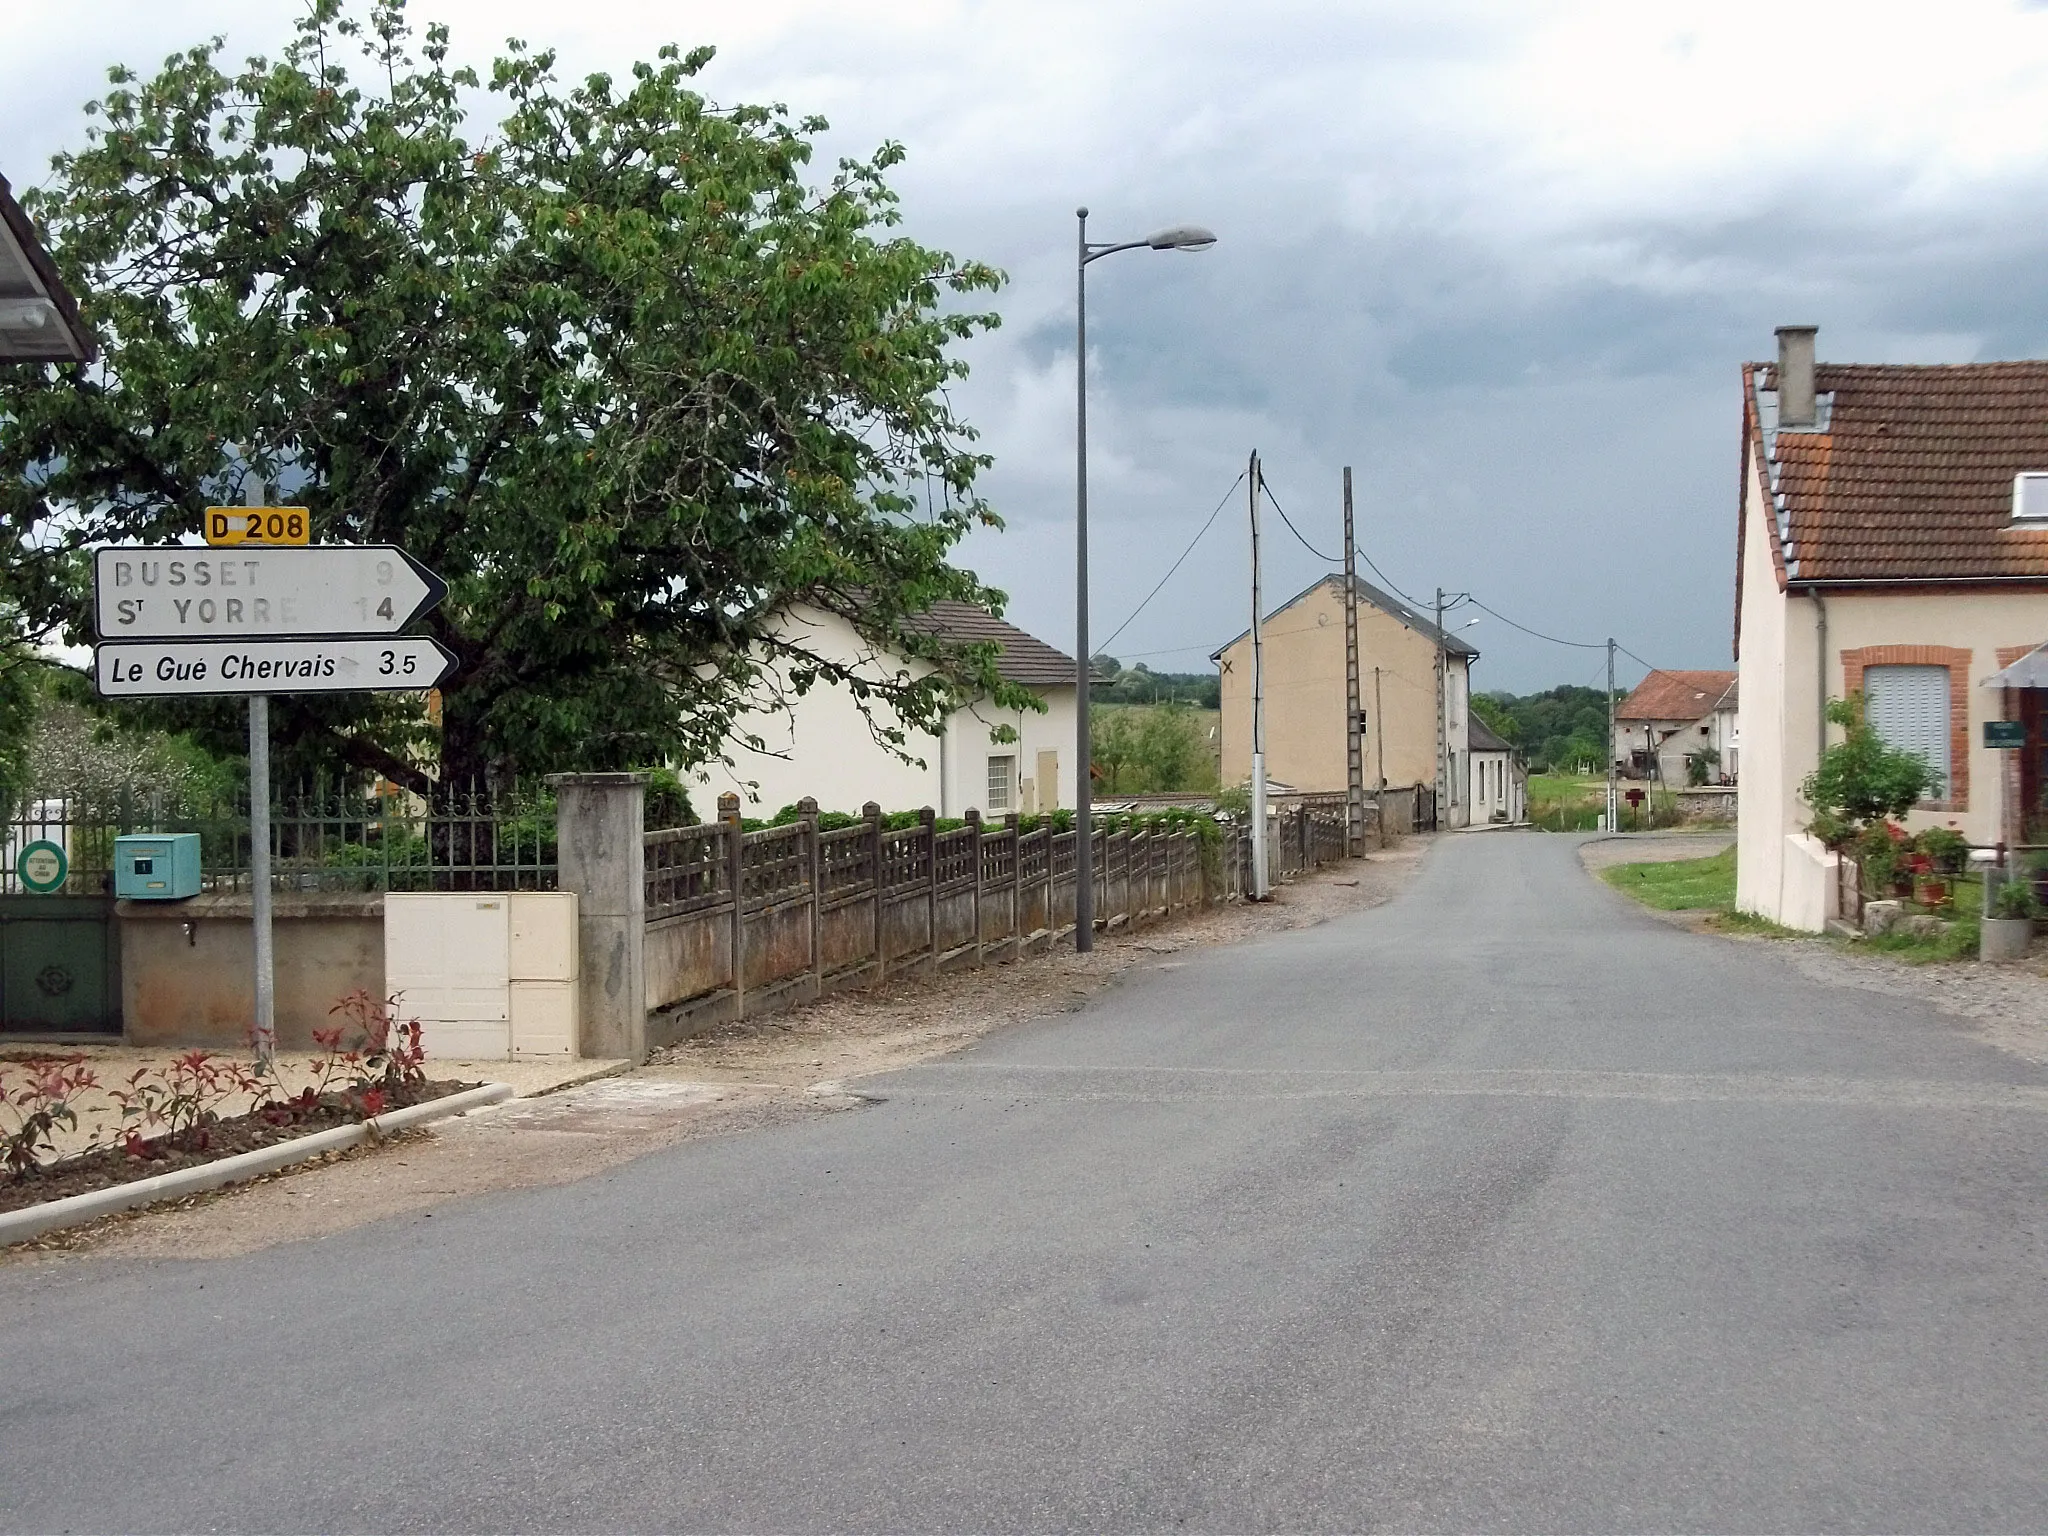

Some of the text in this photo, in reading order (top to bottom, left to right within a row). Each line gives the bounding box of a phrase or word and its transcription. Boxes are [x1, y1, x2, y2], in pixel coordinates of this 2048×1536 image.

[212, 513, 303, 538] D 208
[115, 561, 394, 587] BUSSET 9
[173, 597, 298, 624] YORRE
[112, 650, 417, 682] Le Gué Chervais 3.5
